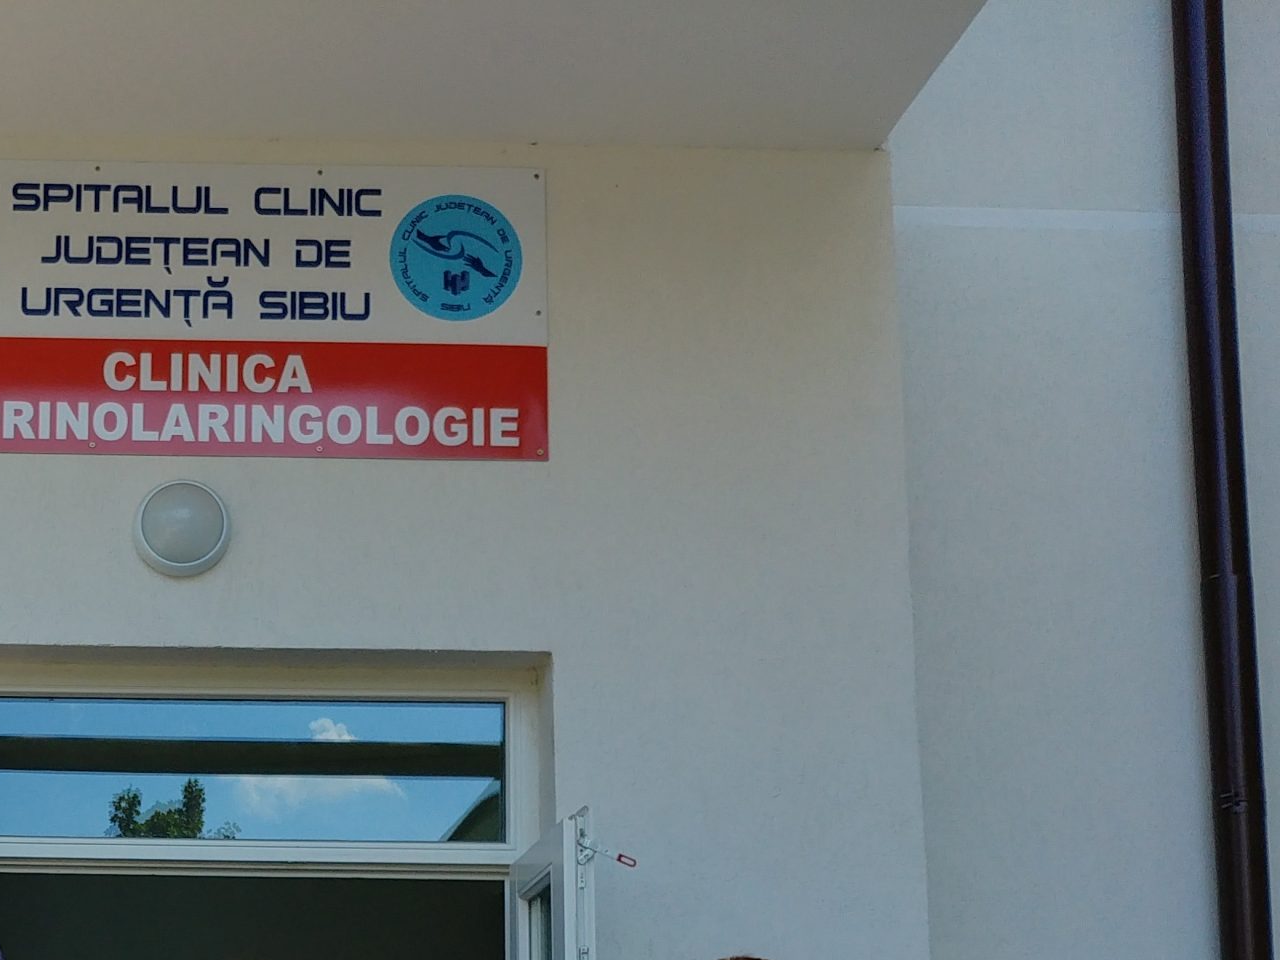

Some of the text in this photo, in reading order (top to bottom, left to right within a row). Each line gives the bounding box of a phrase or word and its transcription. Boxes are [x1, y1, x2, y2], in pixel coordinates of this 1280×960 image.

[12, 182, 383, 217] SPITALUL CLINIC
[402, 210, 429, 241] CLINIC
[496, 228, 510, 244] DE
[41, 235, 352, 275] JUDEȚEAN DE
[398, 247, 430, 302] SPITALUL
[21, 276, 371, 328] URGENȚĂ SIBIU
[440, 303, 471, 312] SIBIU
[102, 351, 313, 394] CLINICA
